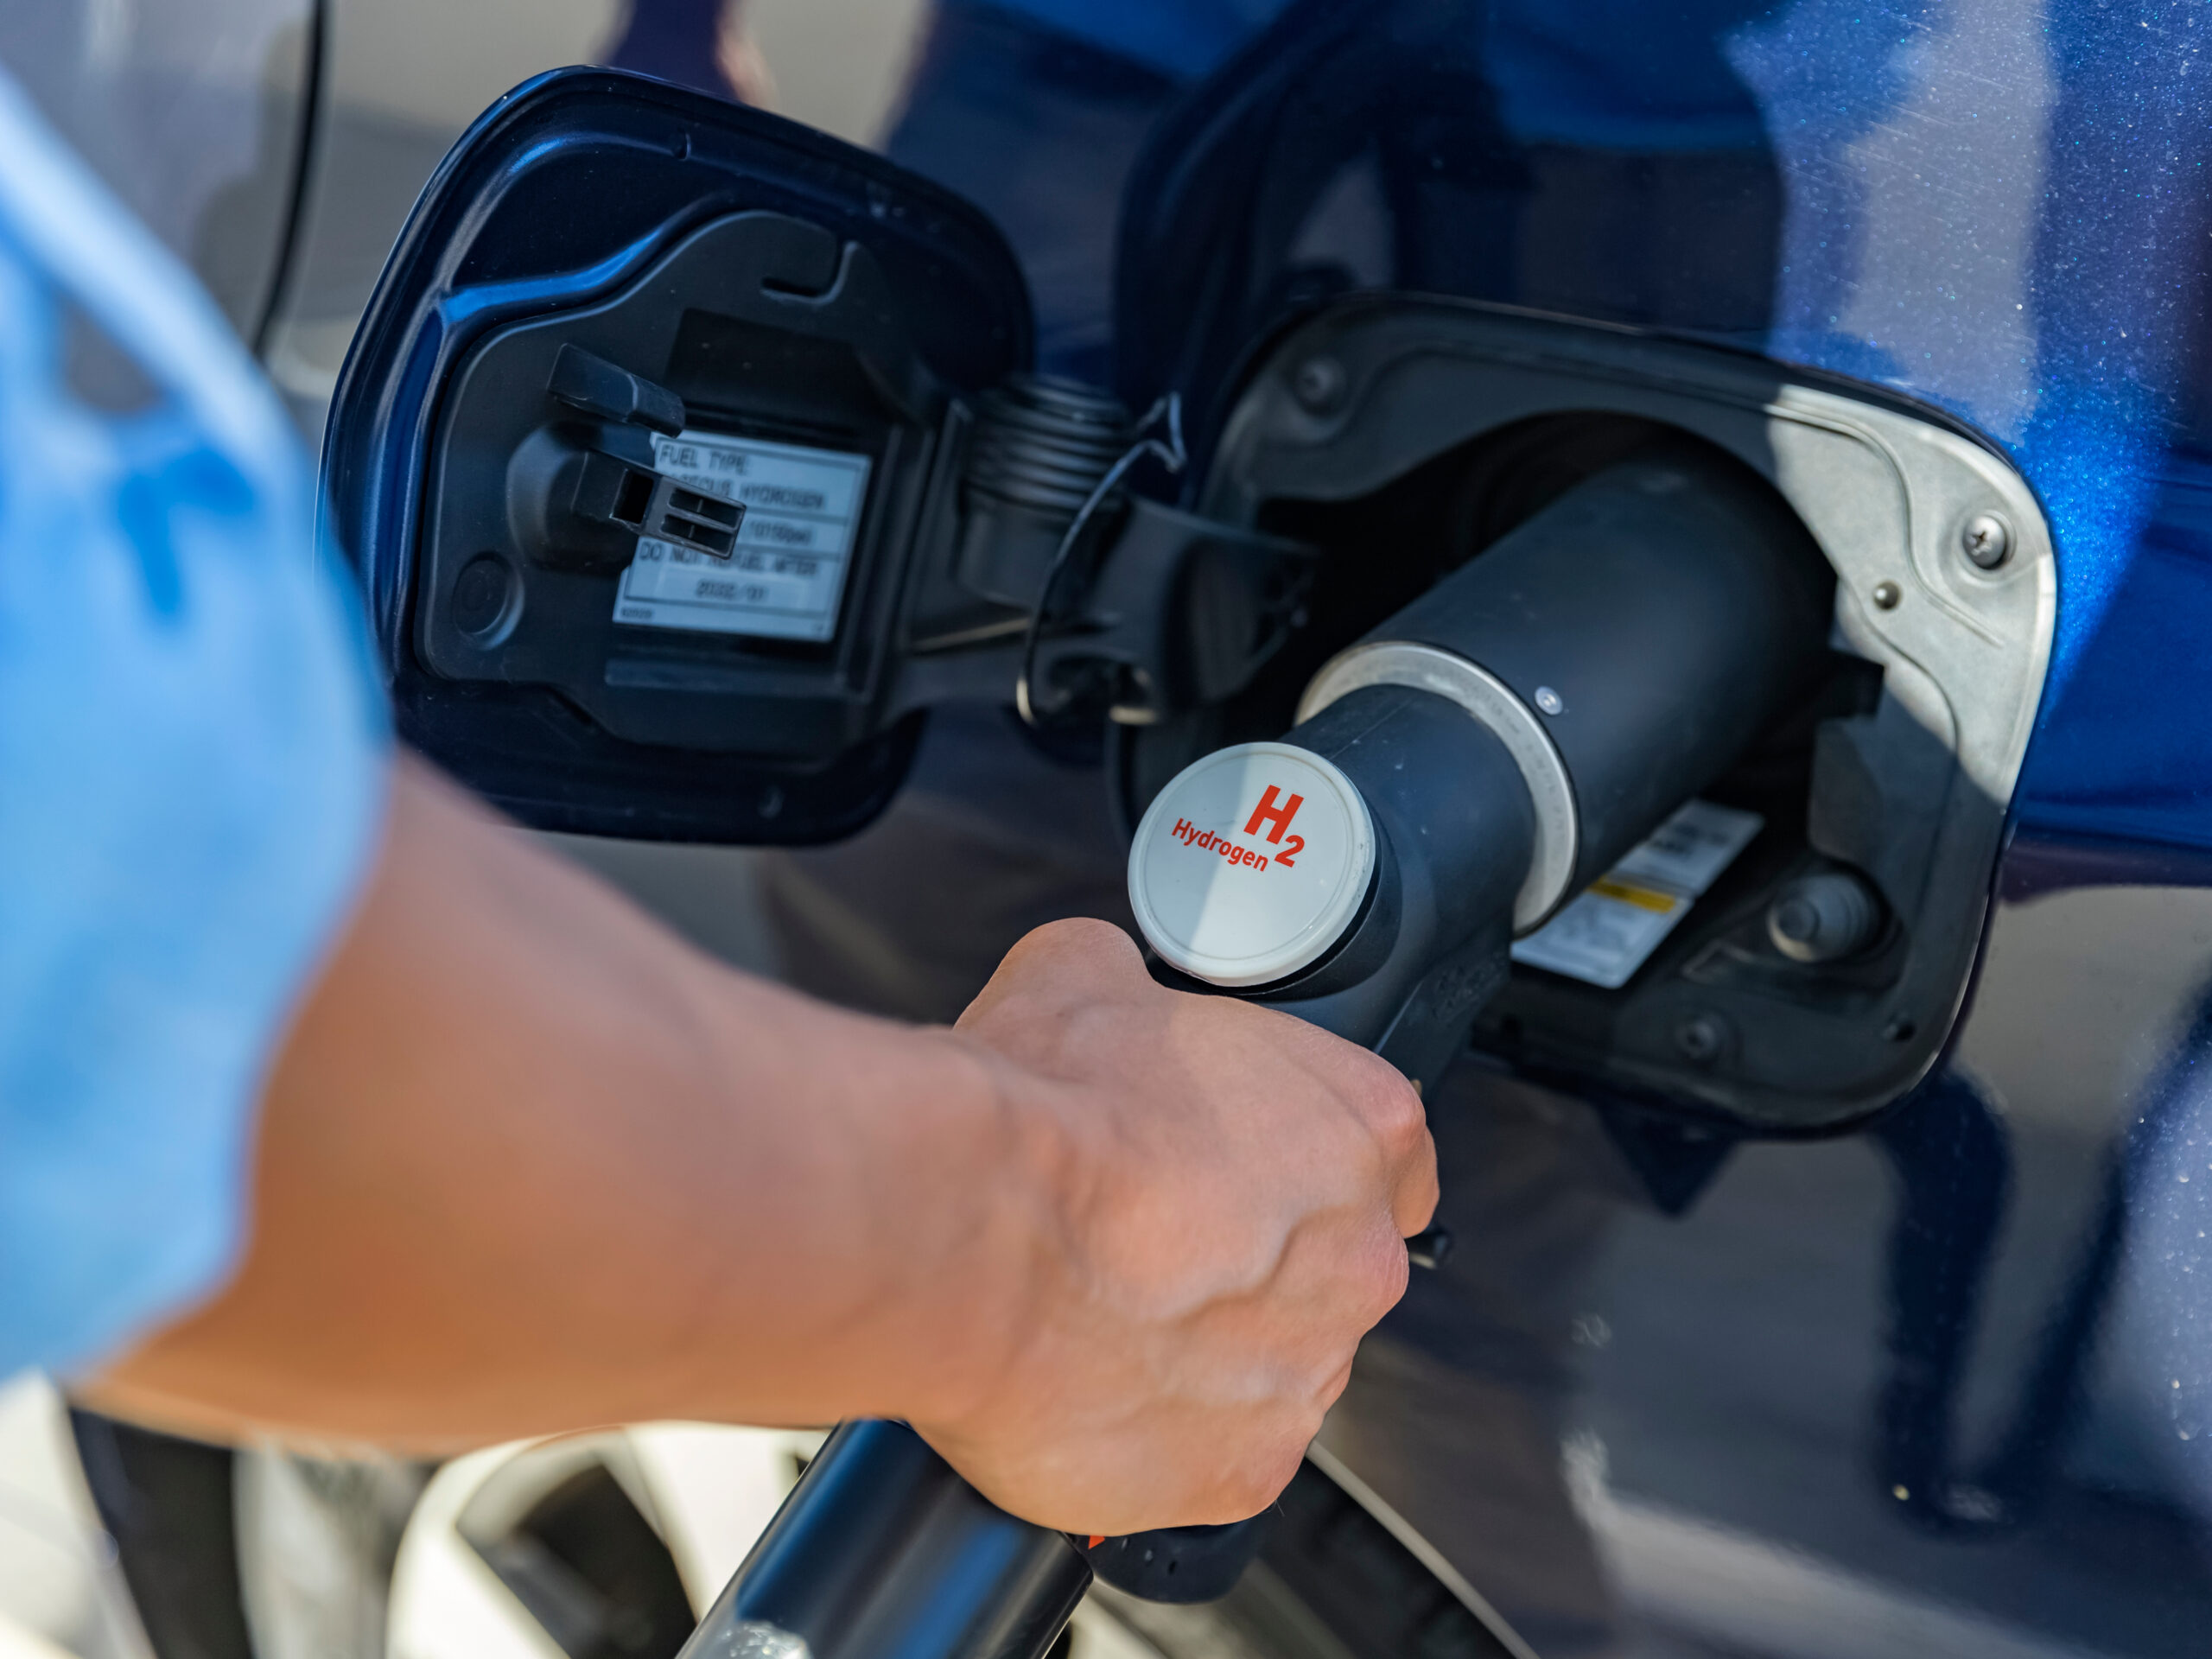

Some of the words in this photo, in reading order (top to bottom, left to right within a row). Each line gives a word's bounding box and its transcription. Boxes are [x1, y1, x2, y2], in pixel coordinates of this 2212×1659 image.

[659, 444, 697, 468] FUEL
[639, 541, 663, 561] DO
[1171, 817, 1268, 872] Hydrogen
[1243, 785, 1305, 868] H2
